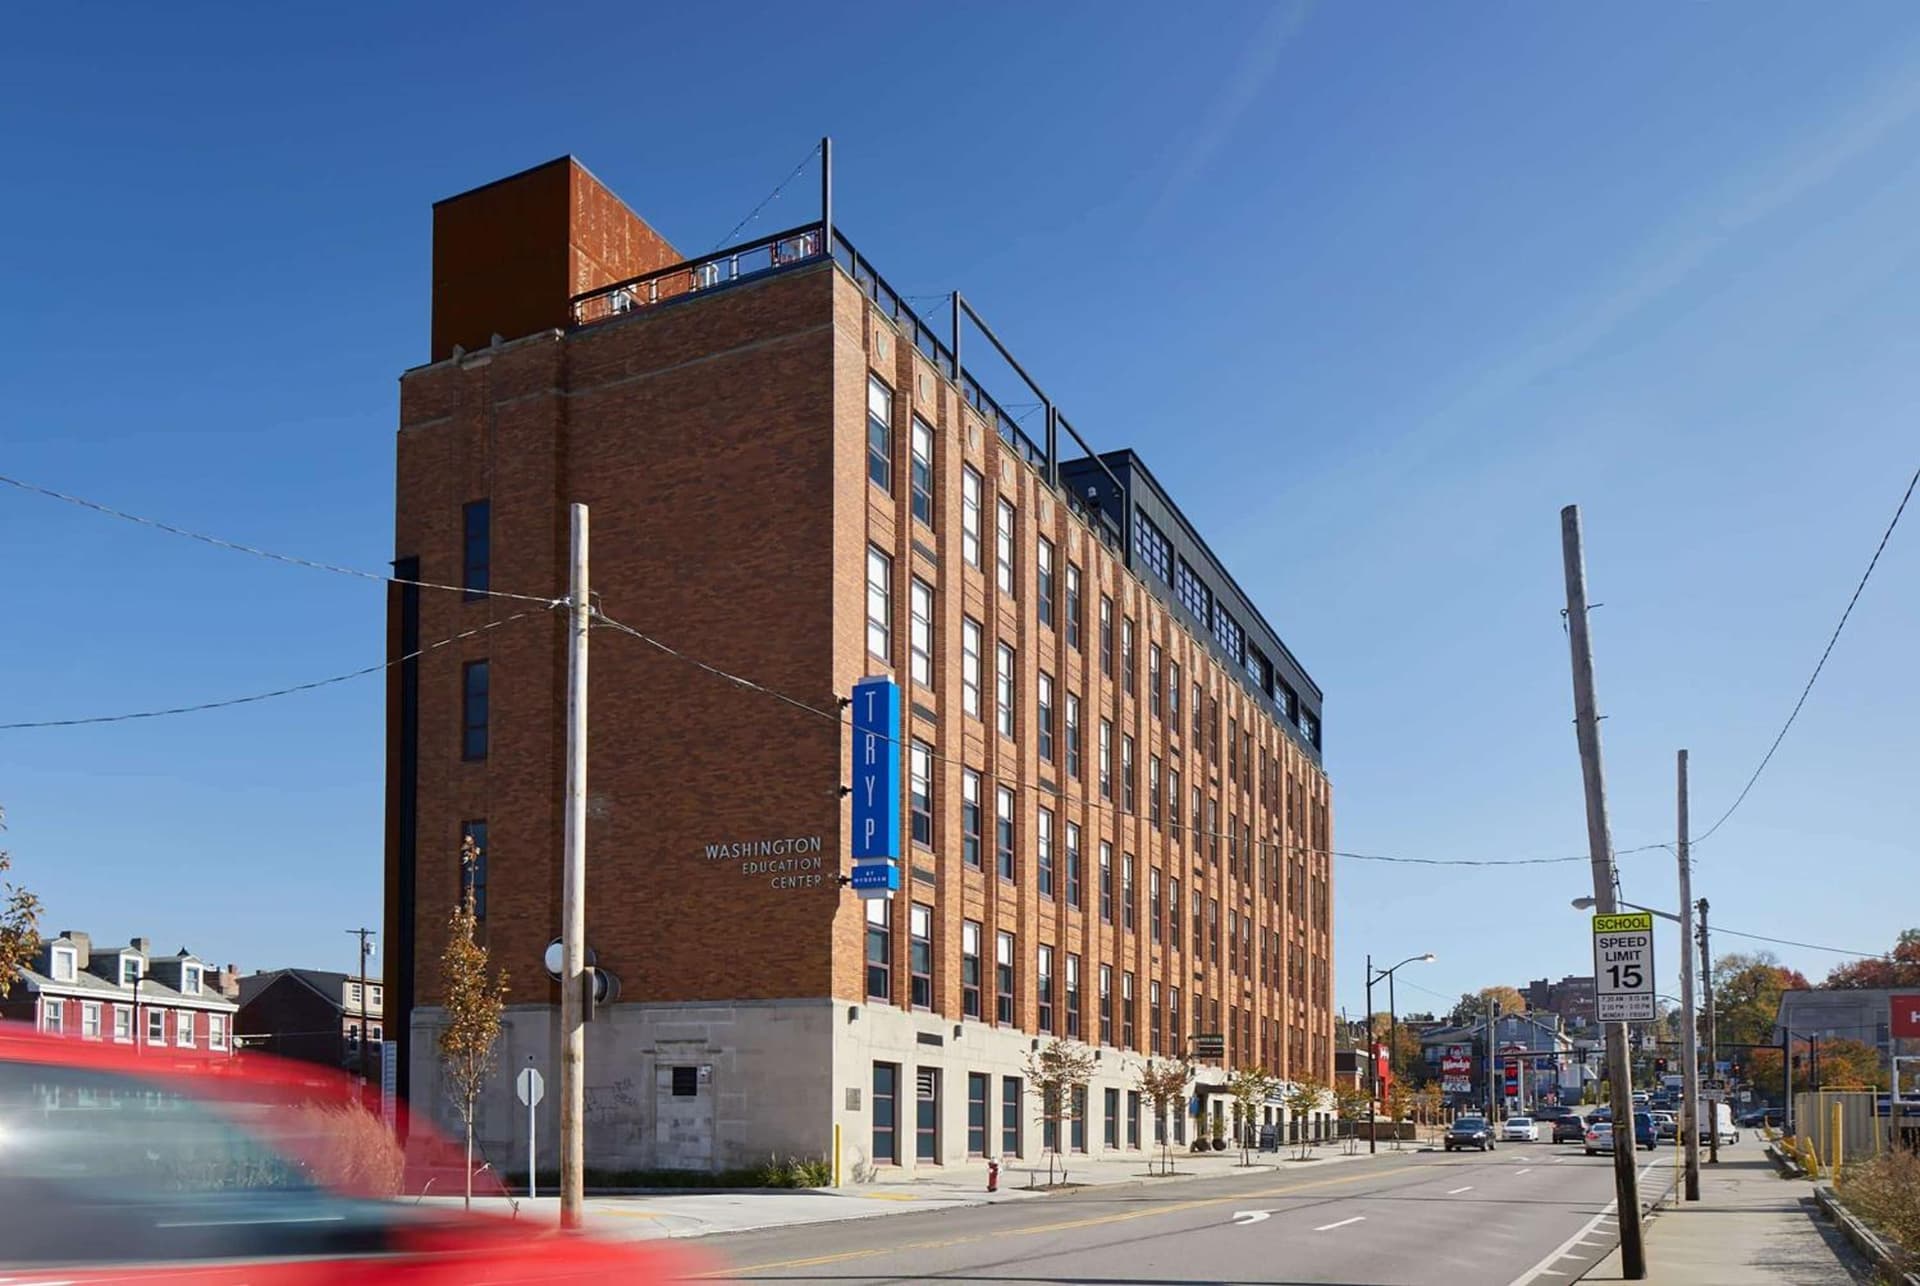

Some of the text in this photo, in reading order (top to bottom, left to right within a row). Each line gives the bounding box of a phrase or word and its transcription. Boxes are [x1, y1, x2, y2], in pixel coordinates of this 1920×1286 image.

[865, 691, 876, 849] TRYP
[705, 837, 821, 859] WASHINGTON
[743, 857, 821, 874] EDUCATION
[771, 875, 821, 888] CENTER
[1596, 918, 1649, 930] SCHOOL
[1599, 937, 1647, 949] SPEED
[1605, 950, 1642, 962] LIMIT
[1606, 964, 1643, 989] 15
